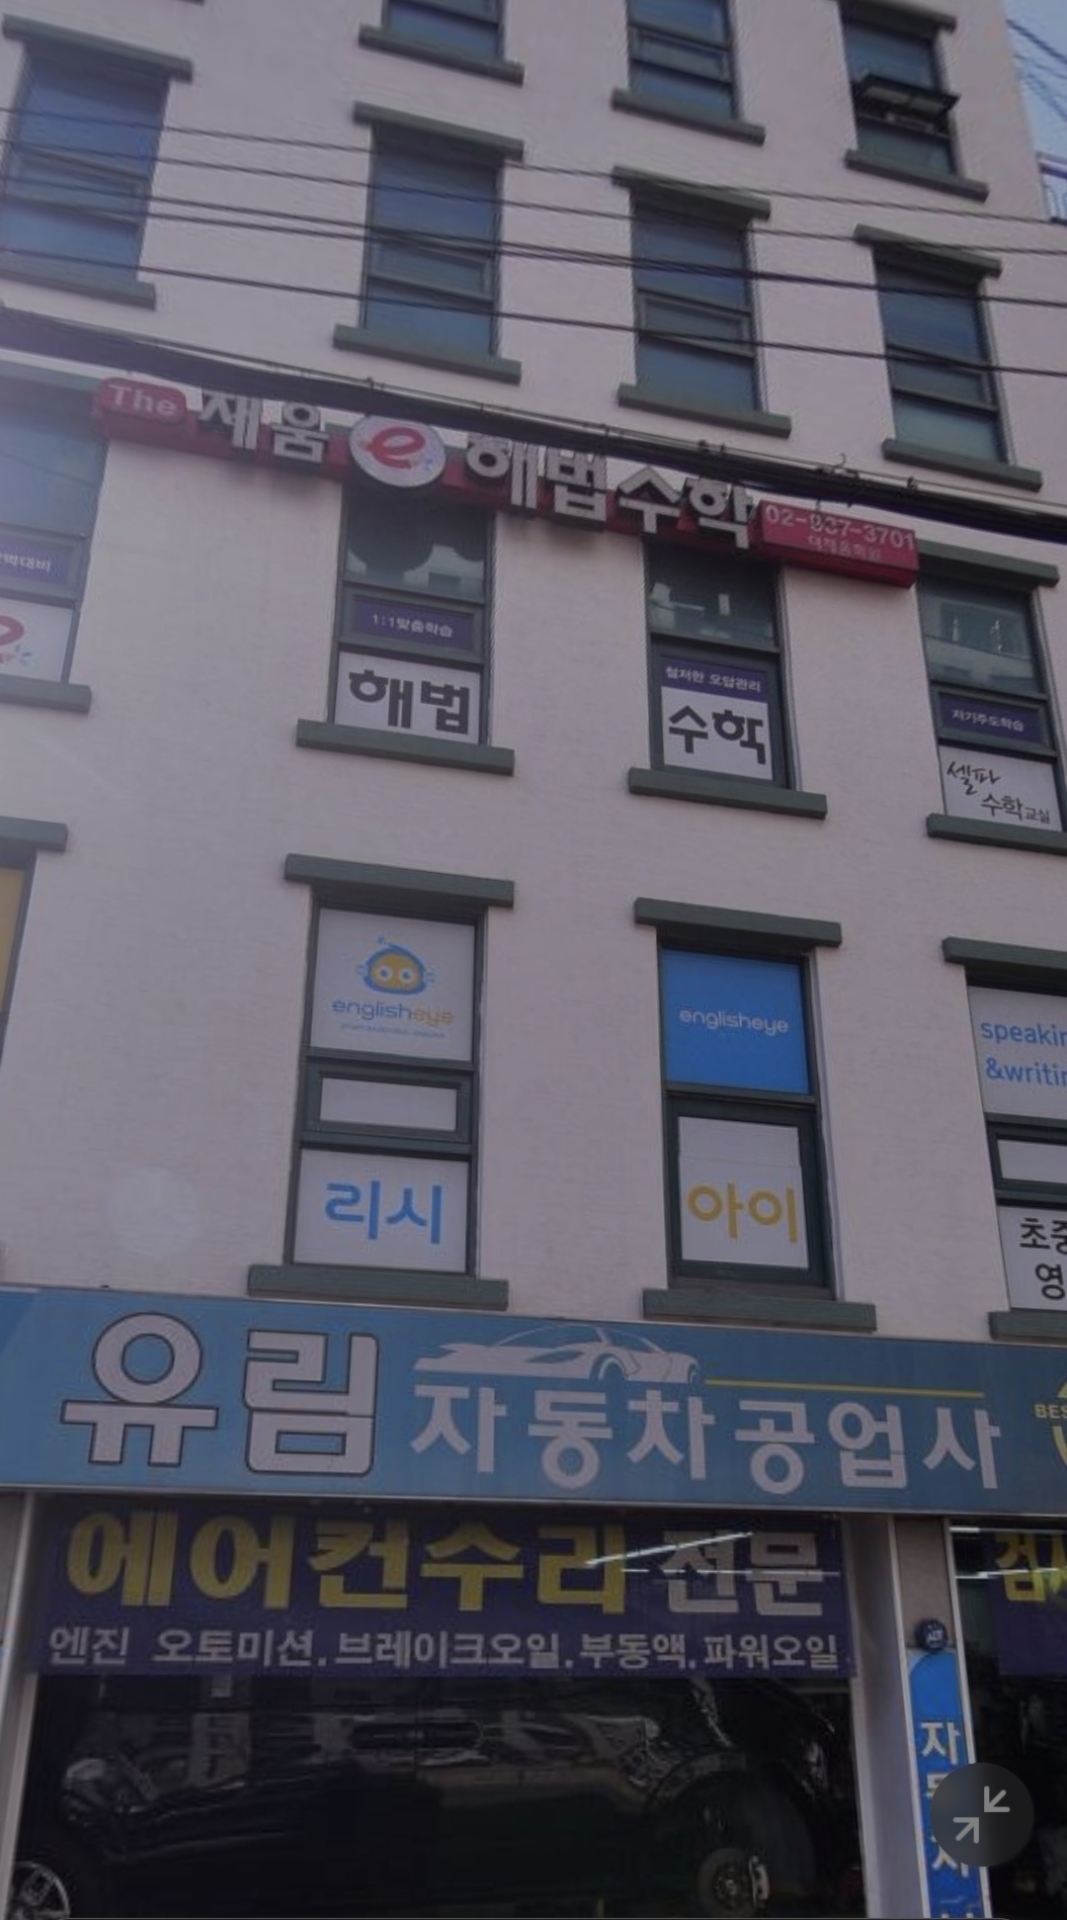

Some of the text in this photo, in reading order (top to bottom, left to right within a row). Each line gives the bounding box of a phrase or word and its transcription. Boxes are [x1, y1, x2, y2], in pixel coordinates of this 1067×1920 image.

[108, 384, 178, 416] The
[348, 669, 470, 735] 해법
[669, 705, 767, 765] 수학
[946, 761, 1001, 795] 셀파
[331, 999, 455, 1028] englisheye
[680, 1010, 789, 1036] englisheye
[324, 1180, 442, 1244] 리시
[687, 1181, 798, 1243] 아이
[60, 1311, 1002, 1494] 유림 자동차공업사
[67, 1510, 823, 1616] 에어컨수리 전문
[50, 1626, 129, 1666] 엔진
